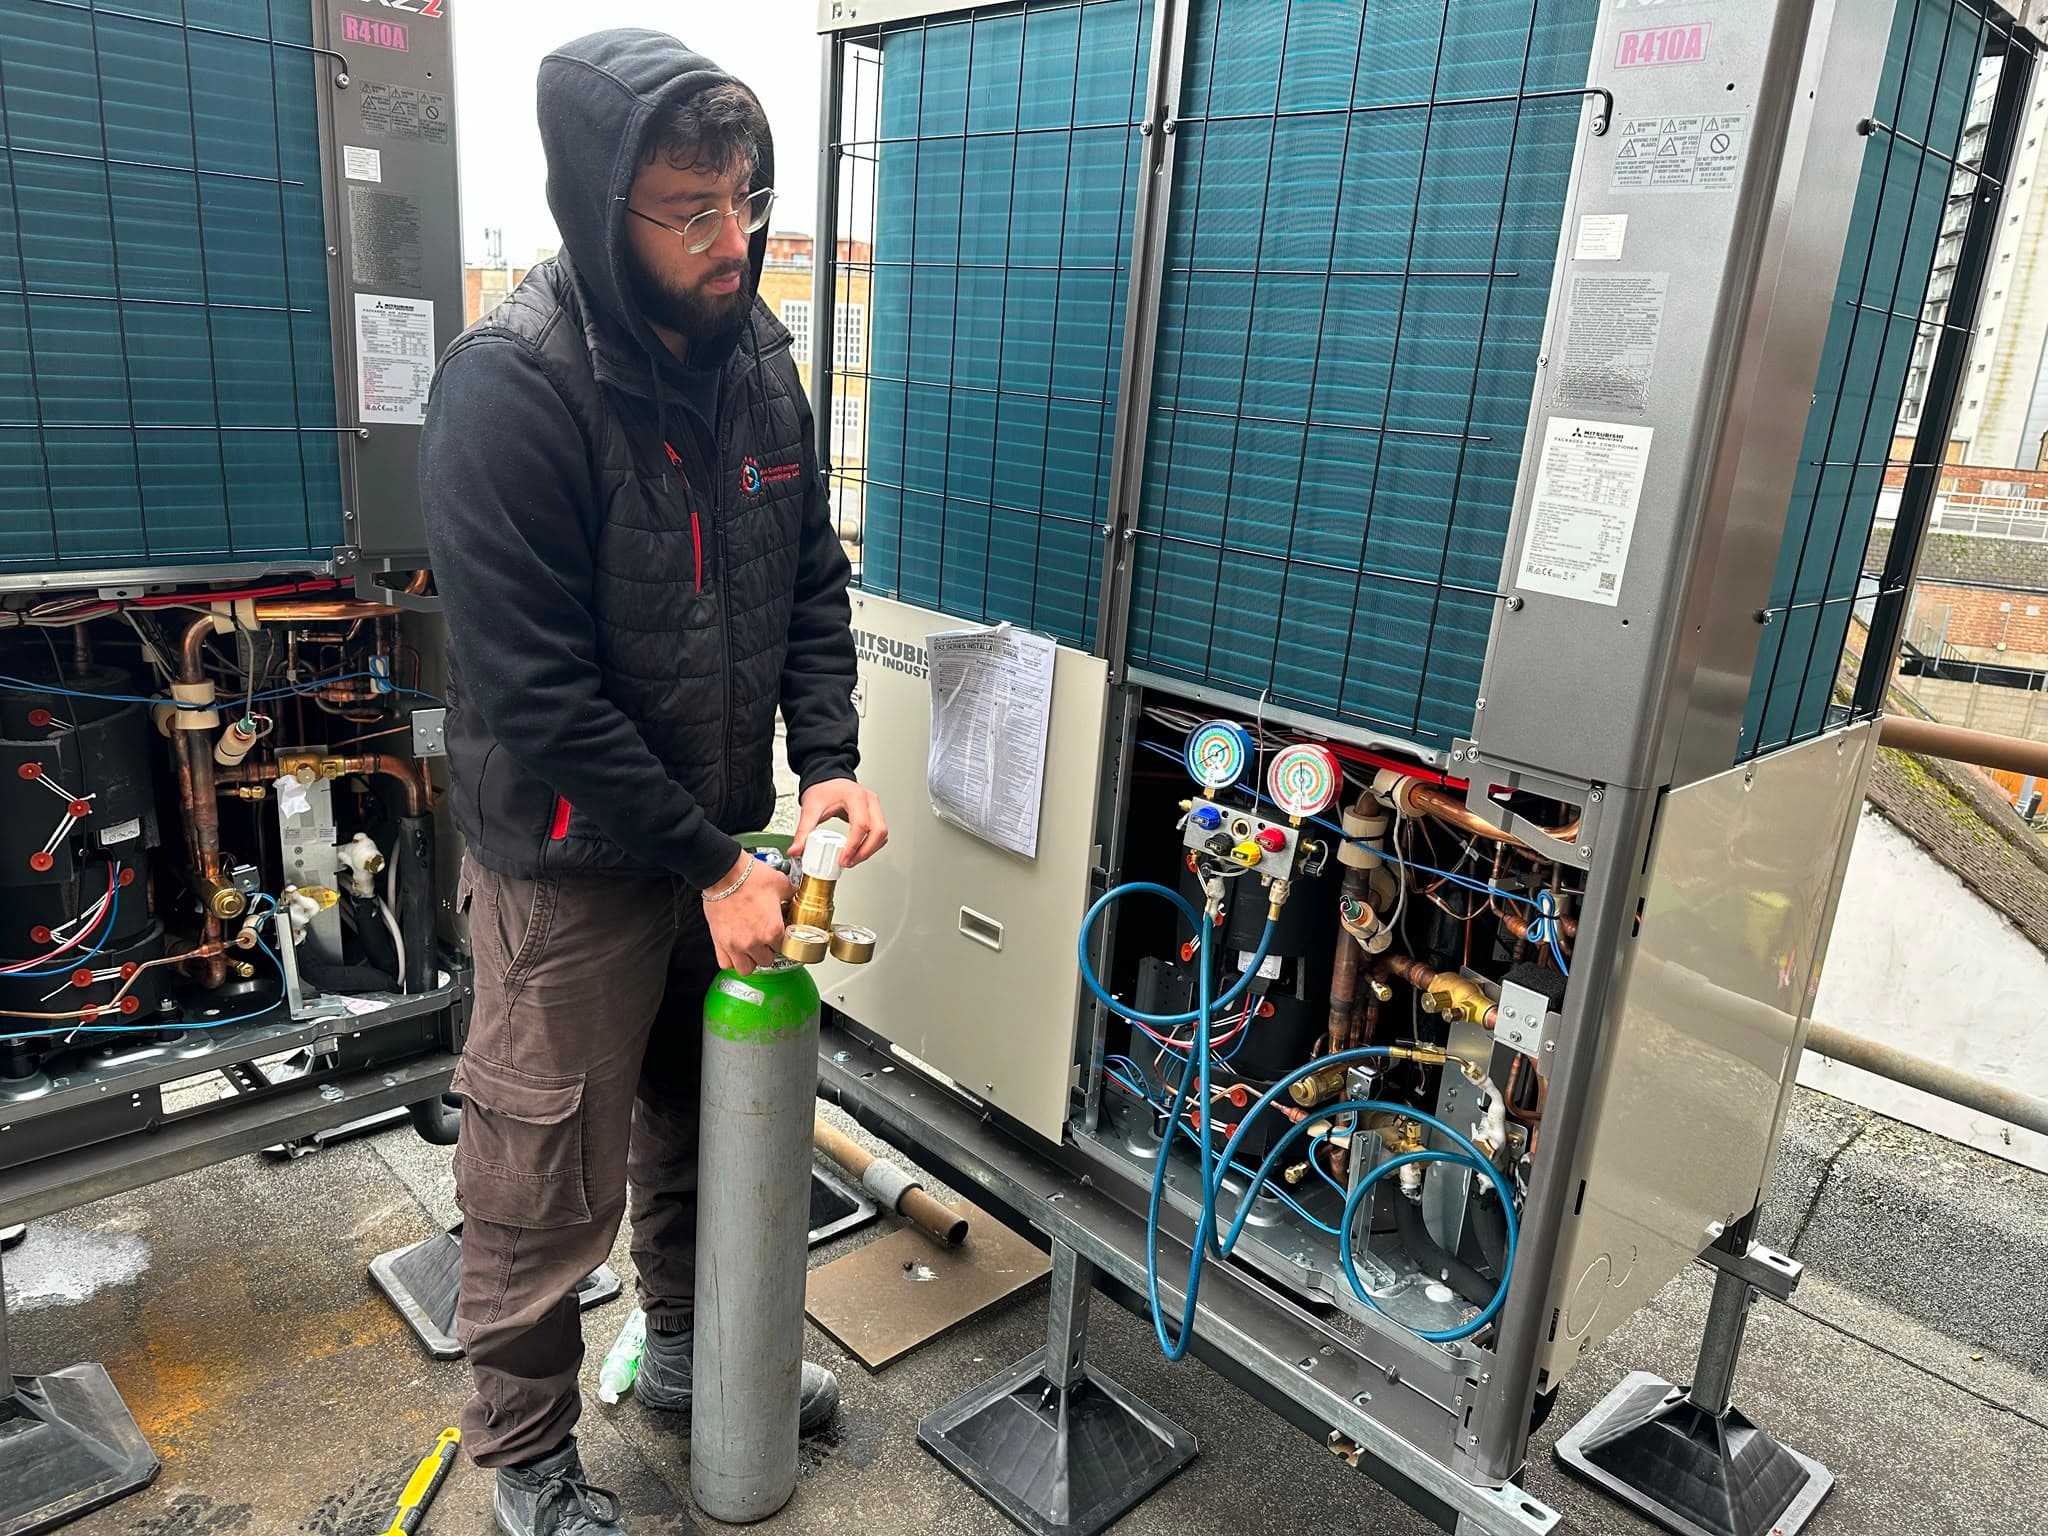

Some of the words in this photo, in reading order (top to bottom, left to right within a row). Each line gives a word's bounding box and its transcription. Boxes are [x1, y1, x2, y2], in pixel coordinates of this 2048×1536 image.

[346, 16, 405, 49] R410A
[1621, 27, 1702, 64] R410A
[1584, 430, 1624, 440] MITSUBISHI
[1600, 442, 1639, 450] CONDITIONER
[857, 649, 879, 664] AVY
[882, 656, 930, 680] INDUST
